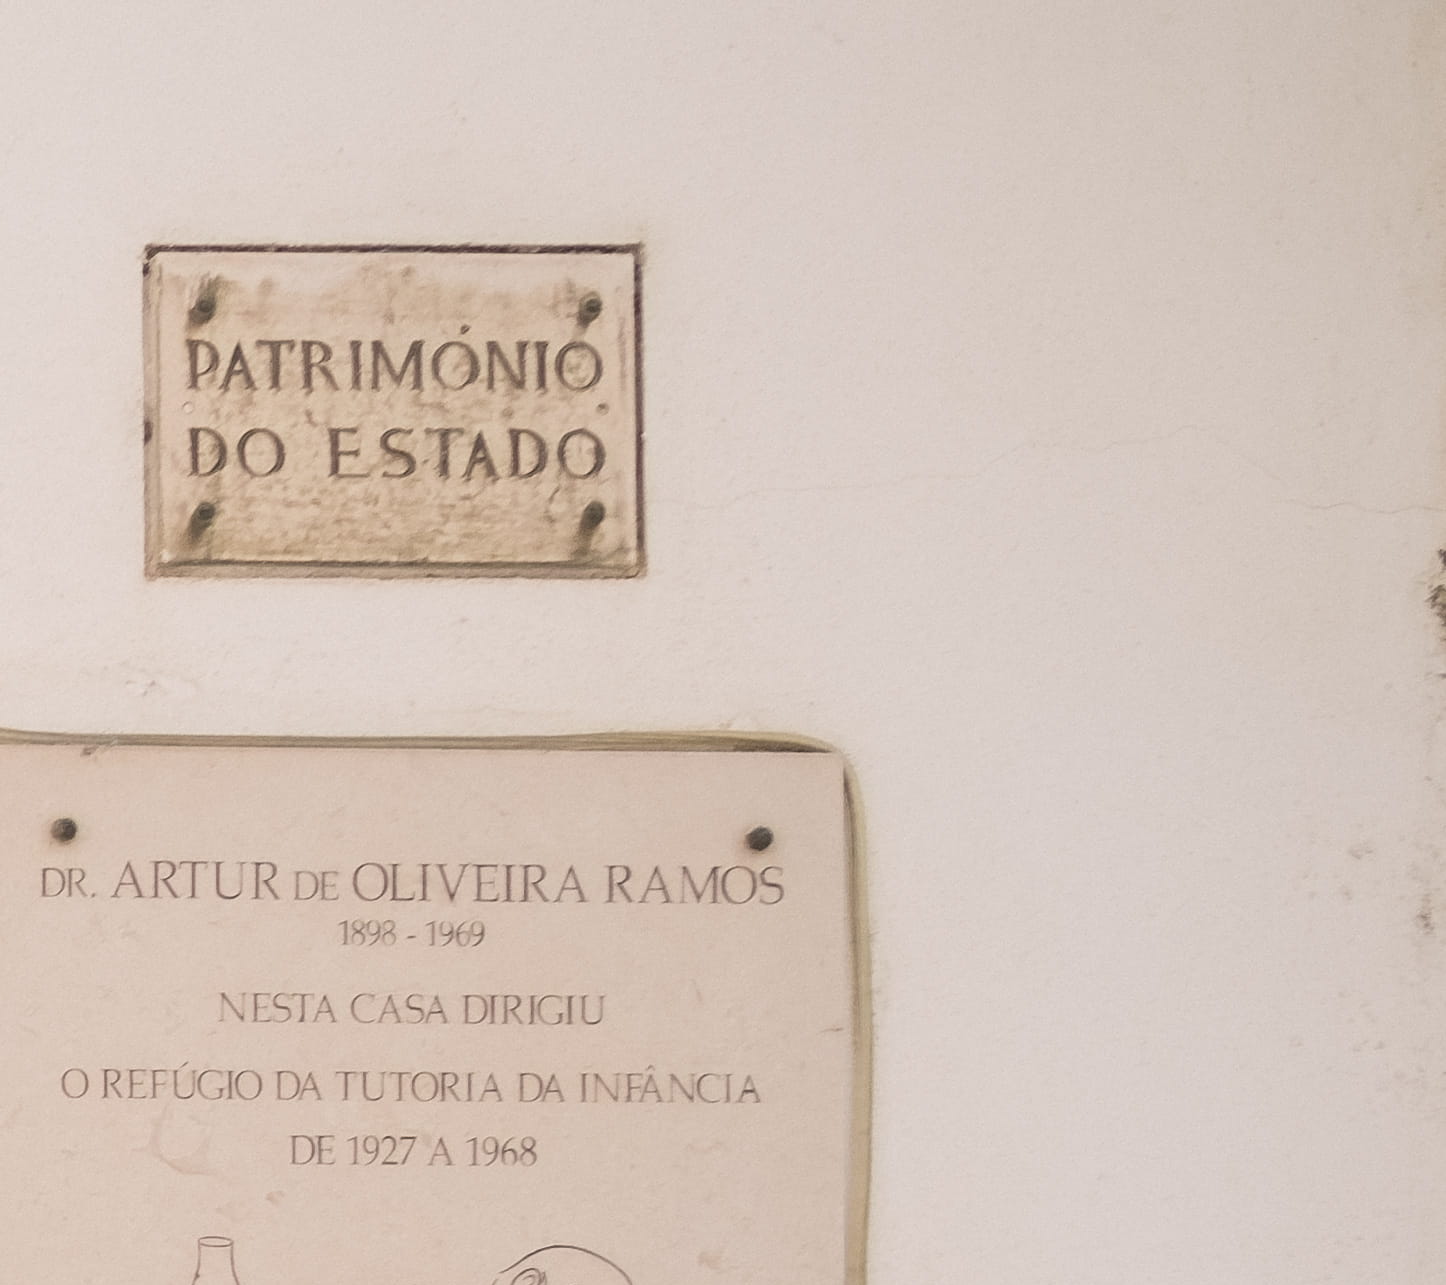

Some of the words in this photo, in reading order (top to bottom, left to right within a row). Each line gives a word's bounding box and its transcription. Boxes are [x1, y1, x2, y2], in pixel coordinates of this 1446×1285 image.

[185, 324, 604, 392] PATRIMÓNIO
[186, 426, 286, 479] DO
[327, 426, 607, 481] ESTADO
[40, 867, 96, 899] DR.
[110, 860, 280, 901] ARTUR
[293, 870, 340, 901] DE
[352, 862, 587, 904] OLIVEIRA
[604, 864, 785, 905] RAMOS
[337, 919, 397, 946] 1898
[425, 920, 487, 948] 1969
[218, 991, 337, 1024] NESTA
[350, 992, 448, 1025] CASA
[461, 993, 607, 1026] DIRIGIU
[61, 1067, 90, 1100] O
[101, 1060, 263, 1101] REFÚGIO
[275, 1071, 322, 1101] DA
[335, 1071, 503, 1103] TUTORIA
[517, 1072, 566, 1103] DA
[579, 1063, 761, 1104] INFÂNCIA
[289, 1134, 336, 1165] DE
[346, 1135, 417, 1166] 1927
[427, 1136, 454, 1167] A
[464, 1136, 538, 1167] 1968
